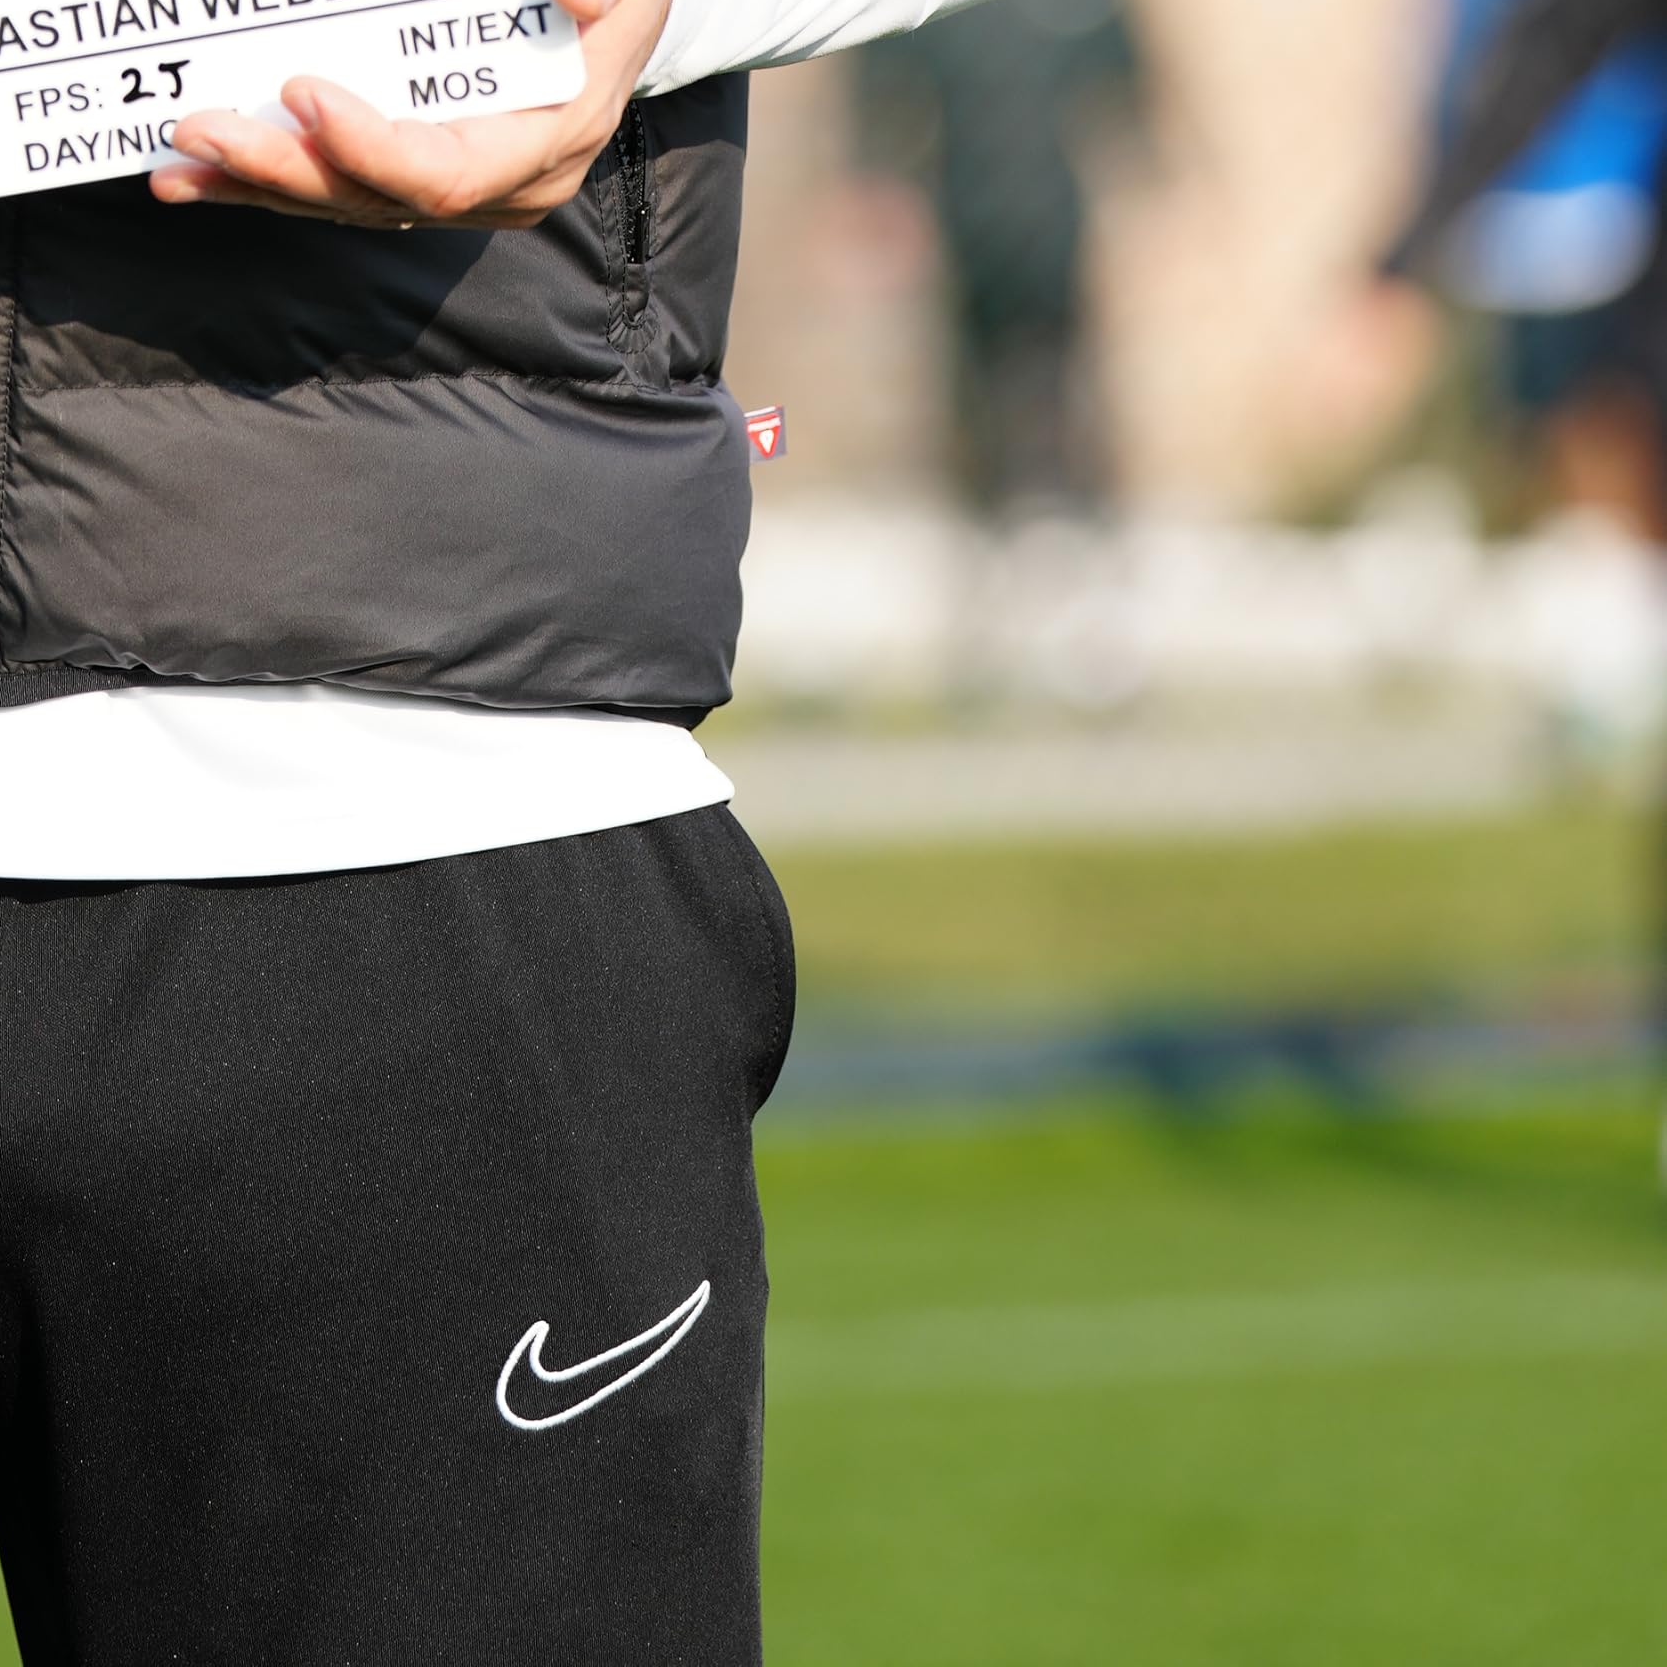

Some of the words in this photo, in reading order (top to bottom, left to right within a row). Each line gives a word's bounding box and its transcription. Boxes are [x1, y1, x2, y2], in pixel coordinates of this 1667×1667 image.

[399, 3, 552, 56] INT/EXT
[14, 82, 103, 122] FPS:
[408, 66, 498, 108] MOS
